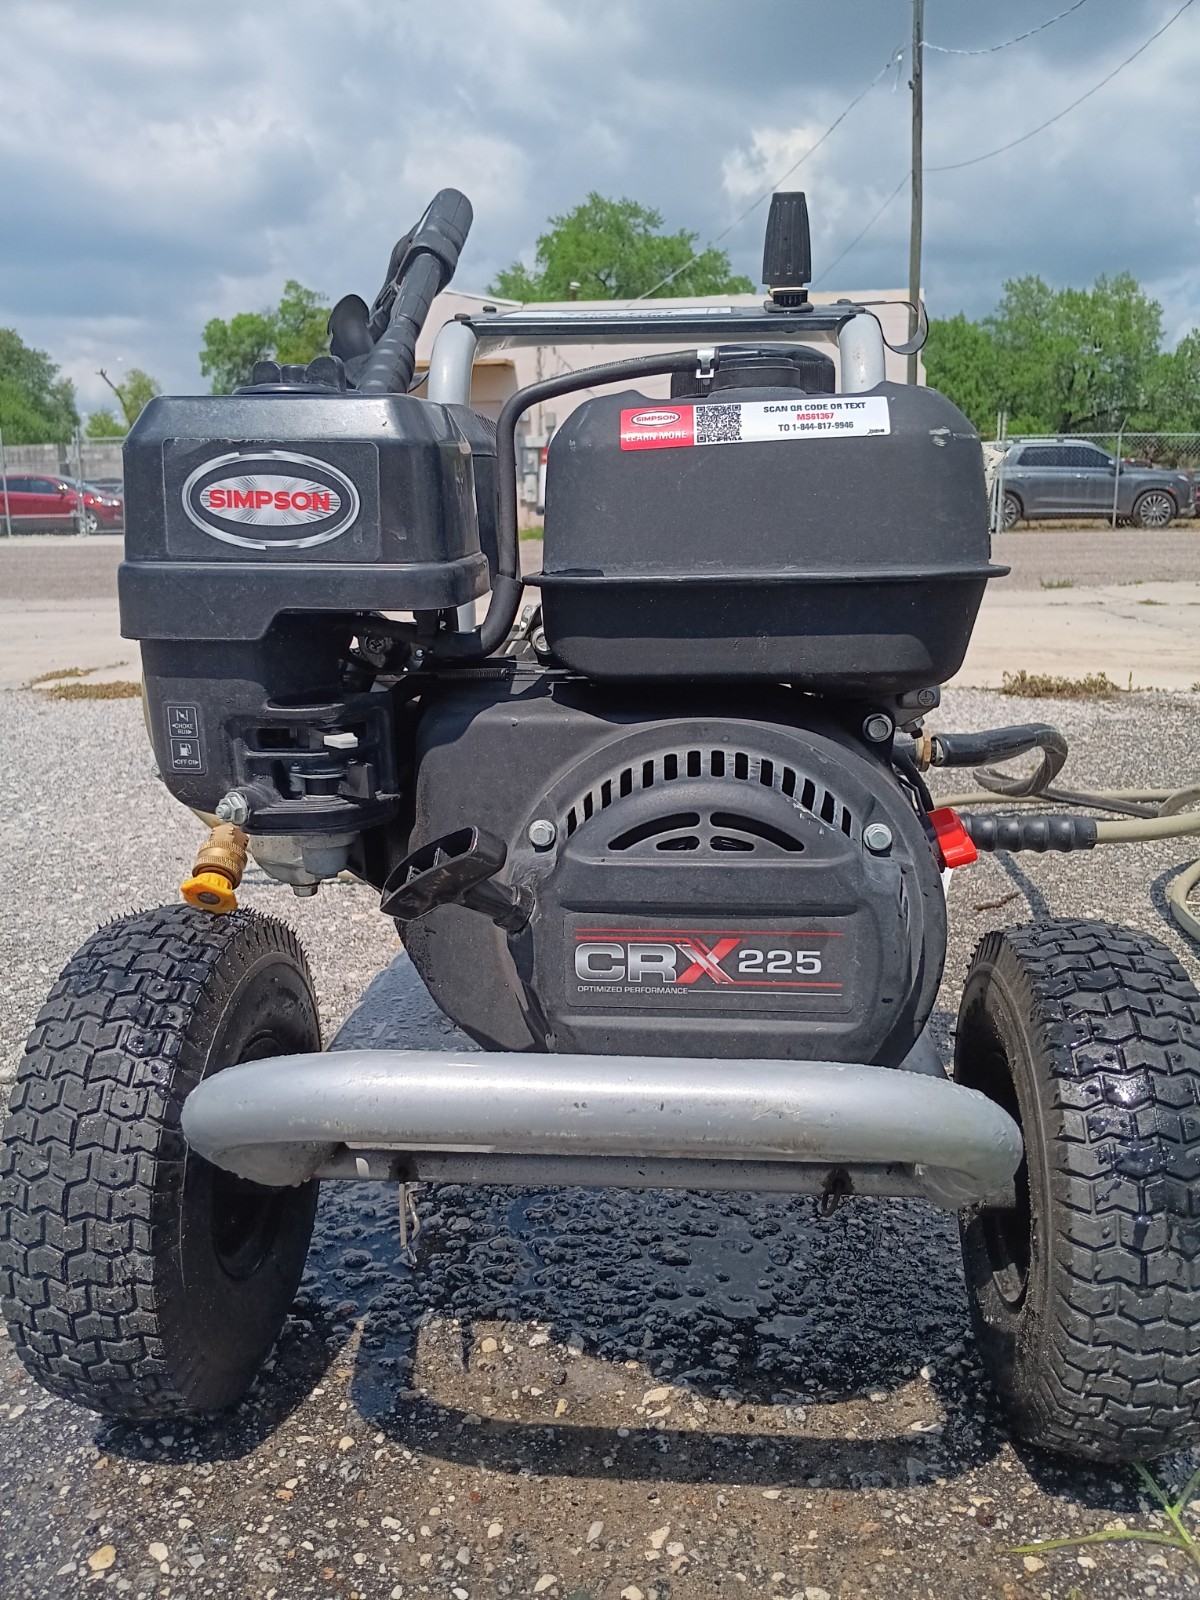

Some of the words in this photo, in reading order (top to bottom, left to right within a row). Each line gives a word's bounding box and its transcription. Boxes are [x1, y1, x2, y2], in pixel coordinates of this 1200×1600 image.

[763, 405, 788, 413] SCAN
[790, 404, 803, 412] QR
[804, 403, 828, 411] CODE
[830, 402, 843, 410] OR
[844, 401, 866, 409] TEXT
[636, 414, 676, 422] SIMPSON
[796, 412, 834, 421] MS61367
[778, 424, 790, 432] TO
[792, 421, 854, 431] 1-844-817-9946
[625, 432, 657, 442] LEARN
[659, 430, 687, 440] MORE
[209, 489, 330, 512] SIMPSON
[574, 938, 742, 984] CRX
[738, 949, 822, 975] 225
[577, 985, 623, 993] OPTIMIZED
[624, 986, 688, 995] PERFORMANCE
